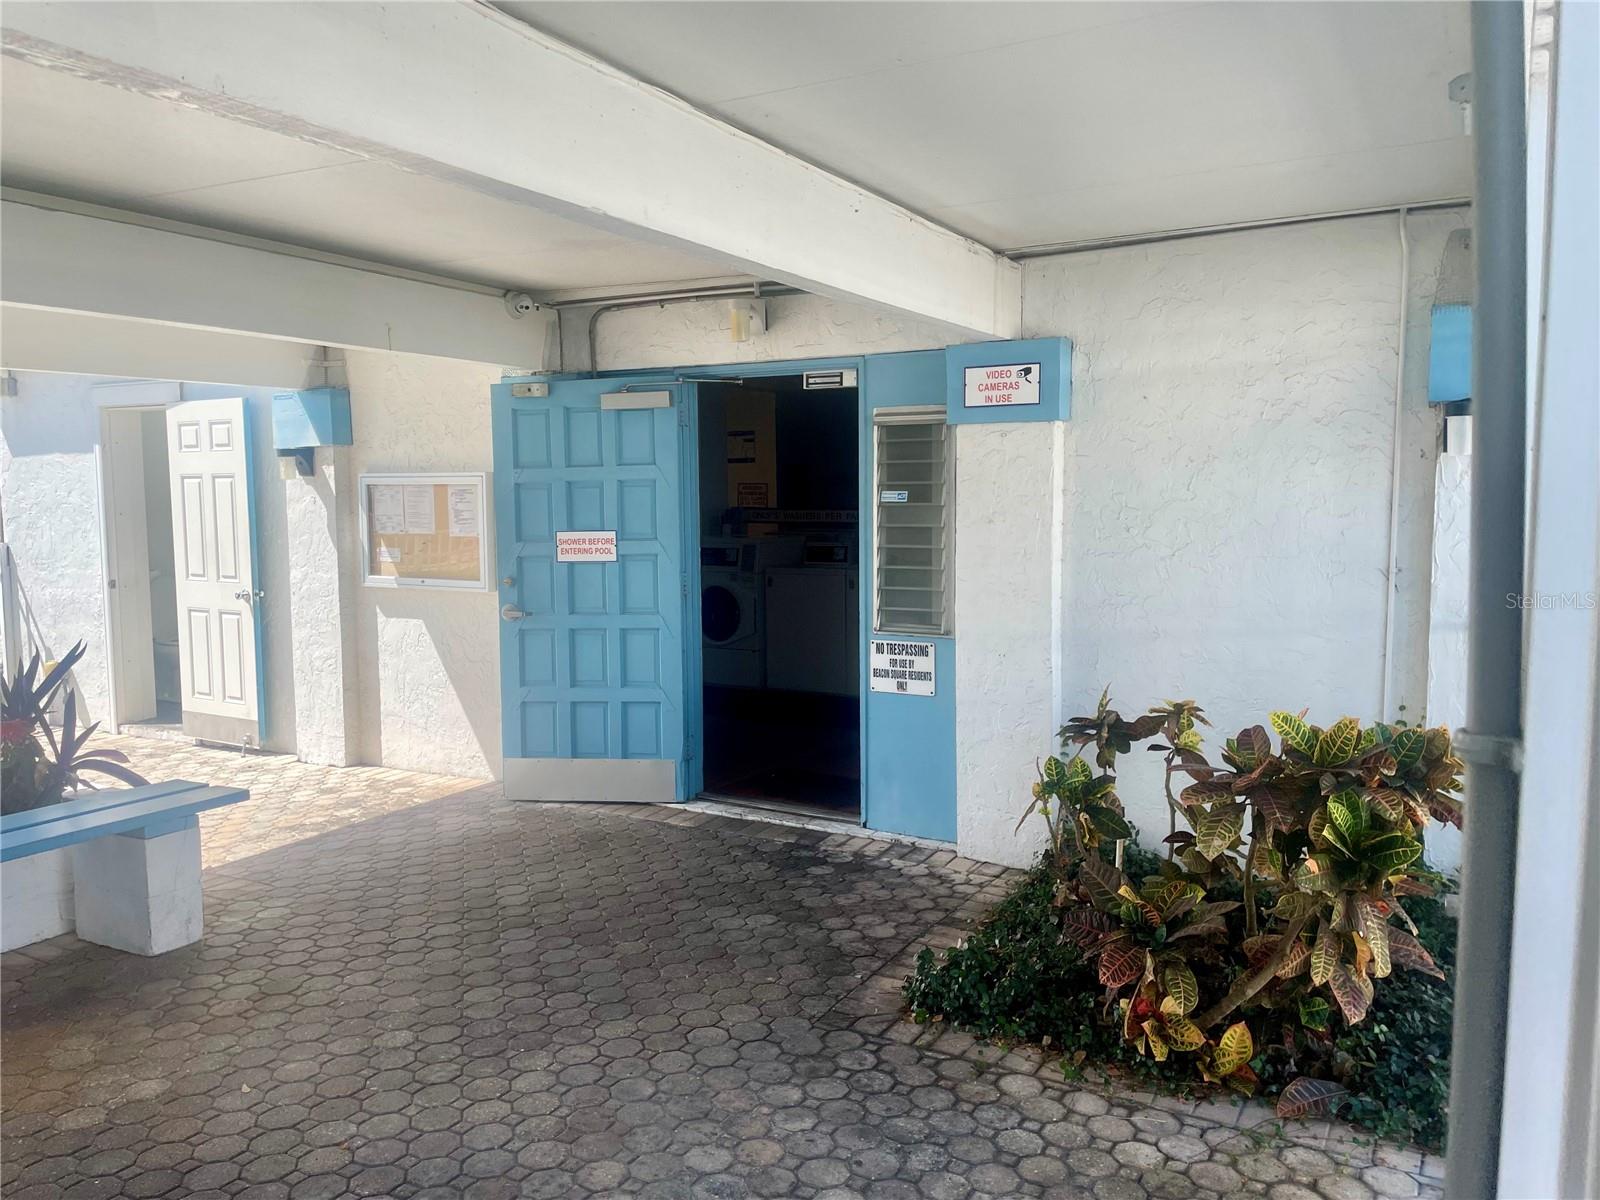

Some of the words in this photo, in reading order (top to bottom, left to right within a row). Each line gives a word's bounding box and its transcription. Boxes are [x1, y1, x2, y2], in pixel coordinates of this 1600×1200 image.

[986, 370, 1012, 379] VIDEO
[978, 381, 1020, 392] CAMERAS
[985, 395, 993, 403] IN
[995, 394, 1013, 403] USE
[558, 538, 587, 546] SHOWER
[588, 537, 615, 545] BEFORE
[560, 547, 594, 555] ENTERING
[595, 547, 614, 555] POOL
[875, 642, 885, 655] NO
[886, 643, 929, 657] TRESPASSING
[889, 658, 898, 668] FOR
[899, 659, 908, 669] USE
[909, 659, 915, 669] BY
[873, 668, 890, 678] BEACON
[891, 669, 908, 680] SQUARE
[908, 670, 932, 681] RESIDENTS
[896, 680, 908, 691] ONLY
